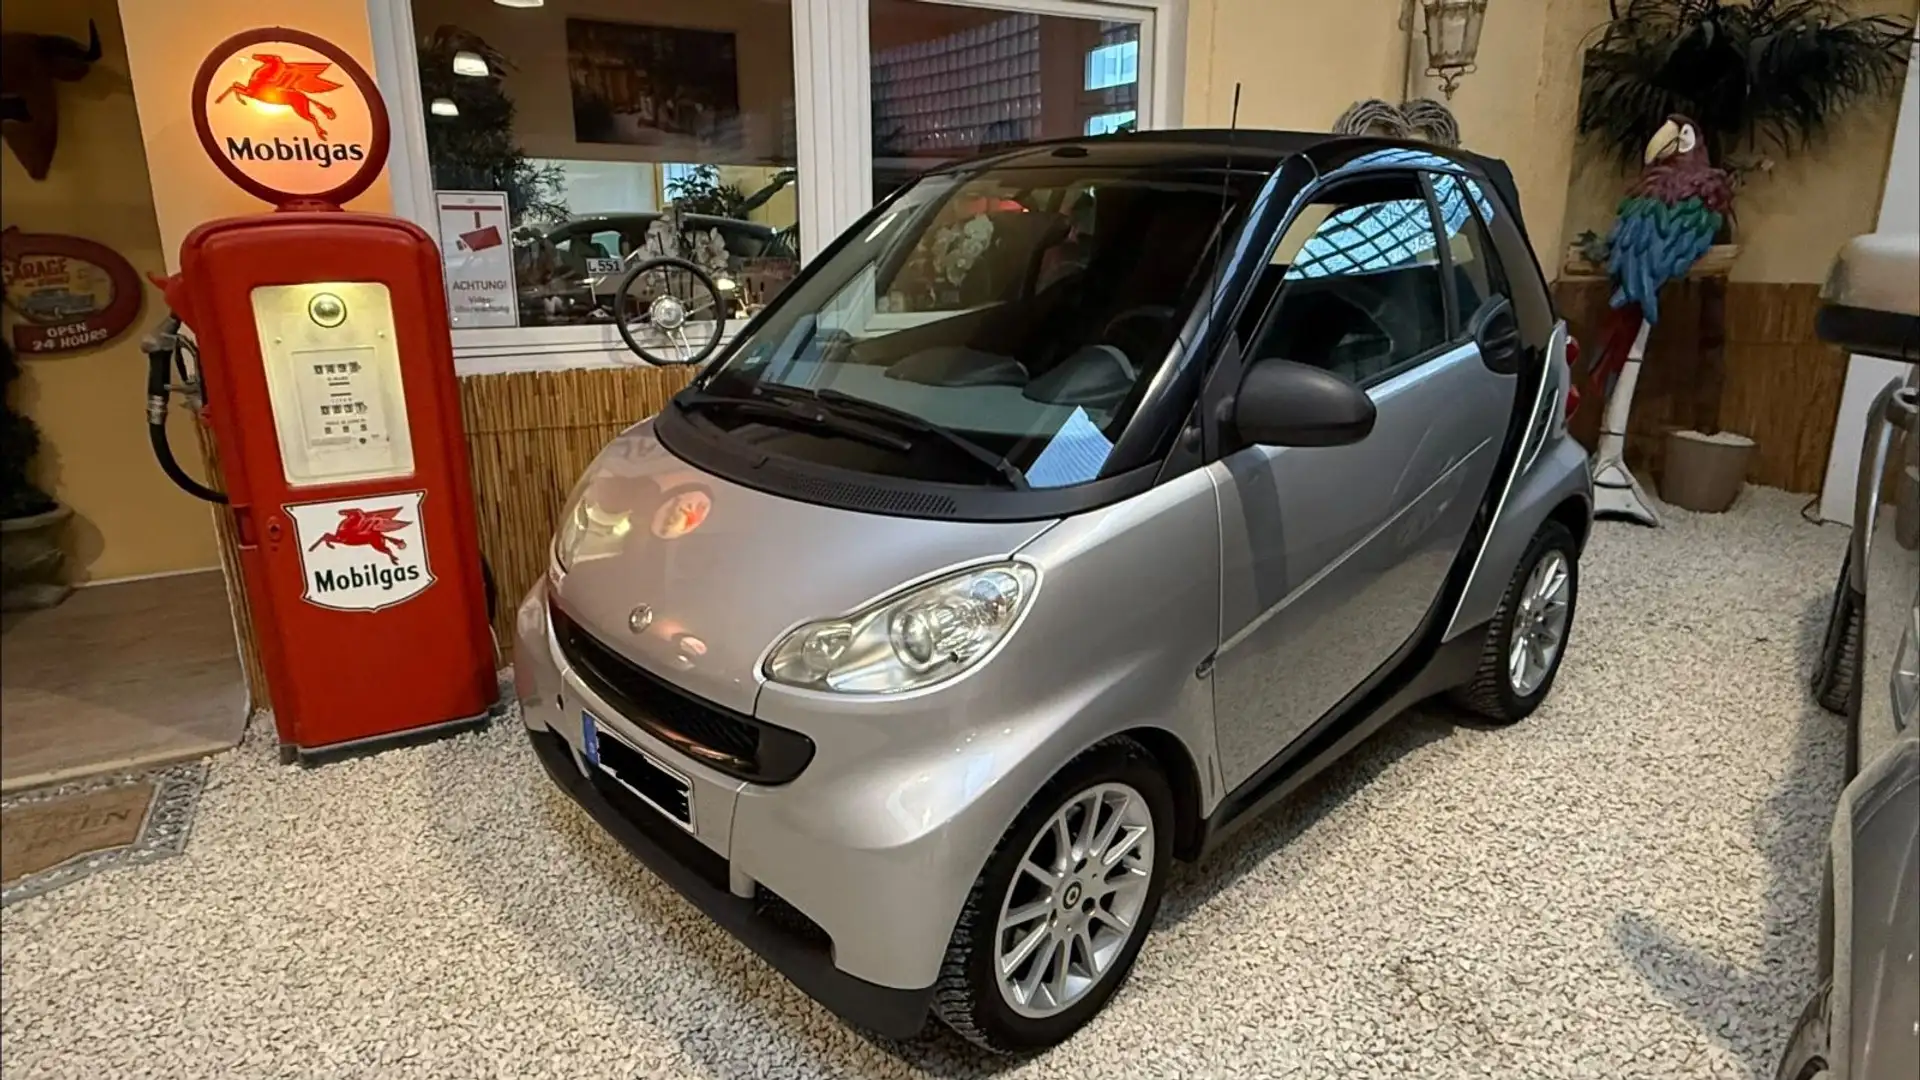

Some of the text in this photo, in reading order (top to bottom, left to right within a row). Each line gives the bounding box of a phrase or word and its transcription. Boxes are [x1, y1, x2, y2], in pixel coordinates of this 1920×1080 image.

[226, 136, 364, 168] Mobilgas
[452, 280, 507, 291] ACHTUNG!
[32, 328, 108, 351] 24 HOURS
[46, 322, 87, 338] OPEN
[314, 563, 420, 593] Mobilgas
